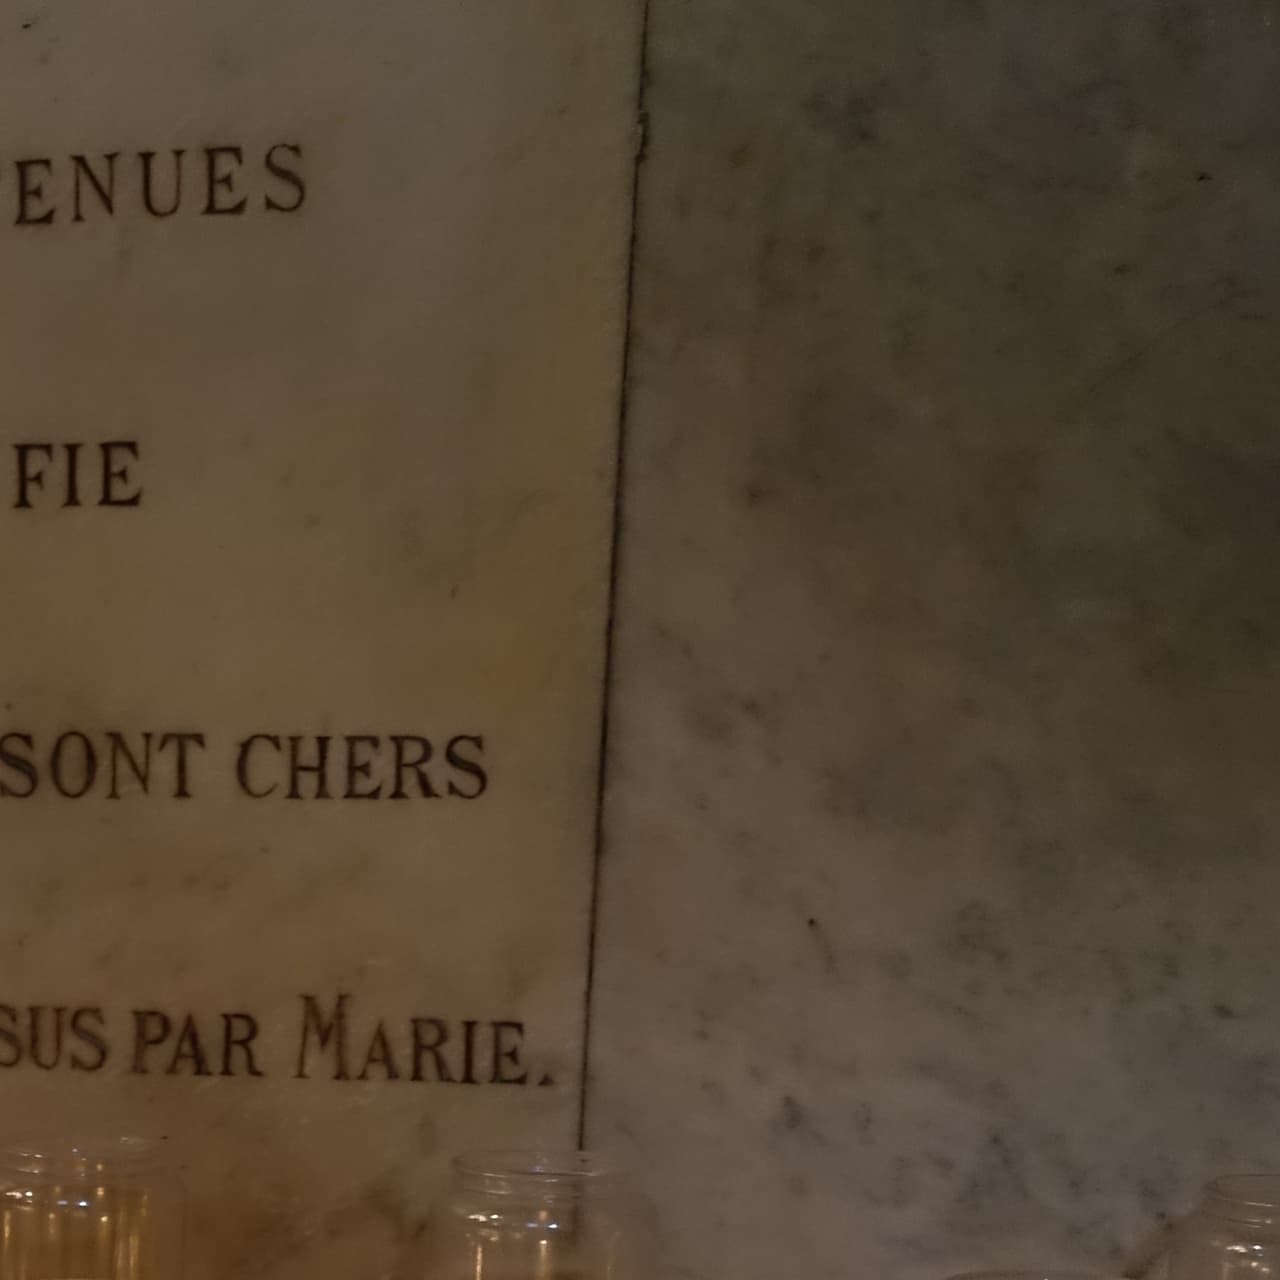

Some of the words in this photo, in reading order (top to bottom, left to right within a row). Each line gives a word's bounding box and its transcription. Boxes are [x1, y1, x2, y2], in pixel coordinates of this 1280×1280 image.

[235, 733, 488, 801] CHERS
[131, 1009, 265, 1078] PAR
[294, 992, 555, 1087] MARIE.
